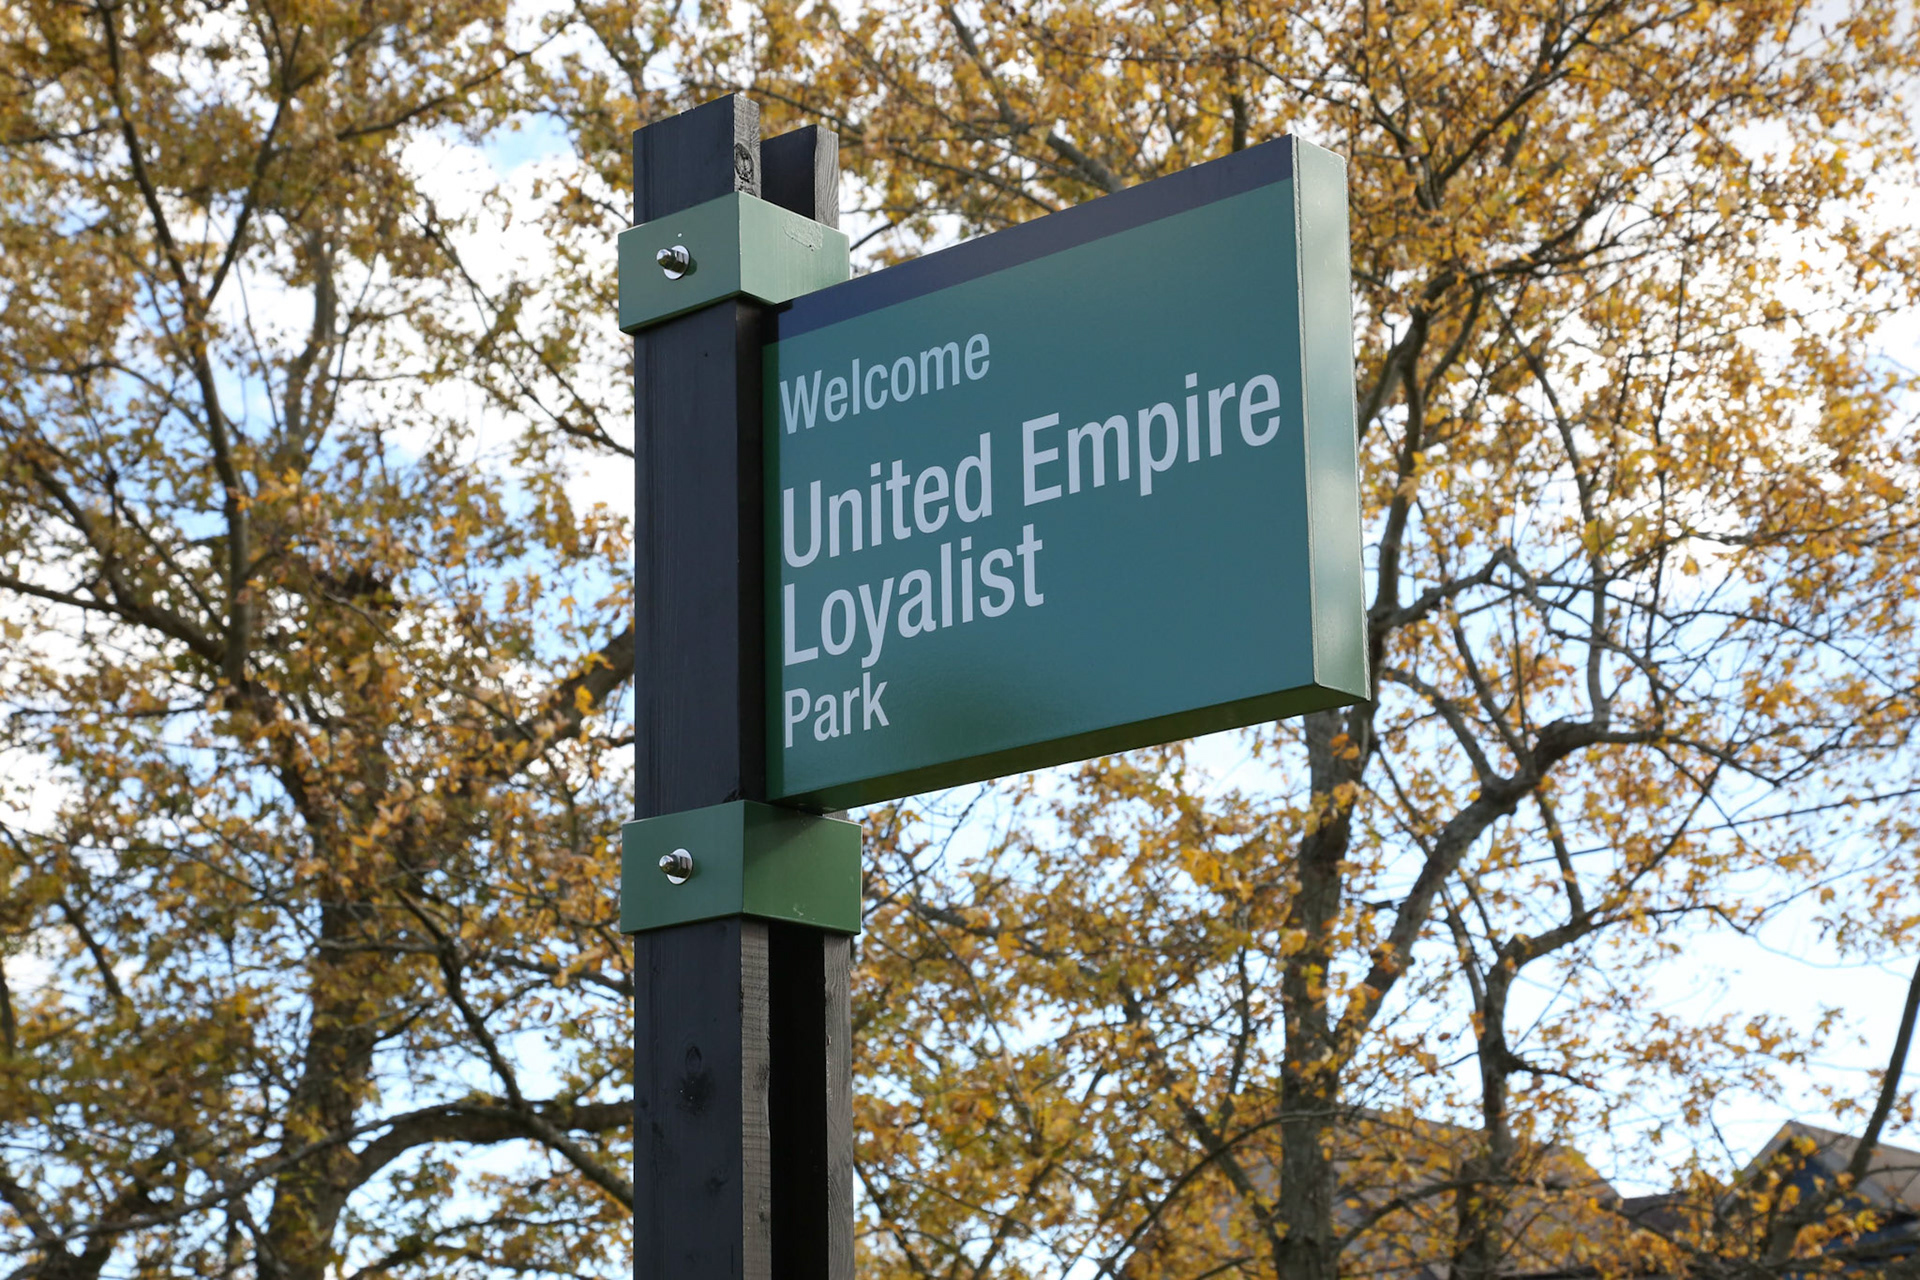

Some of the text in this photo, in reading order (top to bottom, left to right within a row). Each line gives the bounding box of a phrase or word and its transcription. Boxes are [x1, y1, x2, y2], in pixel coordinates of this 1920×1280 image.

[779, 333, 990, 435] Welcome
[783, 373, 1281, 568] United Empire
[784, 523, 1044, 669] Loyalist
[784, 671, 890, 749] Park
